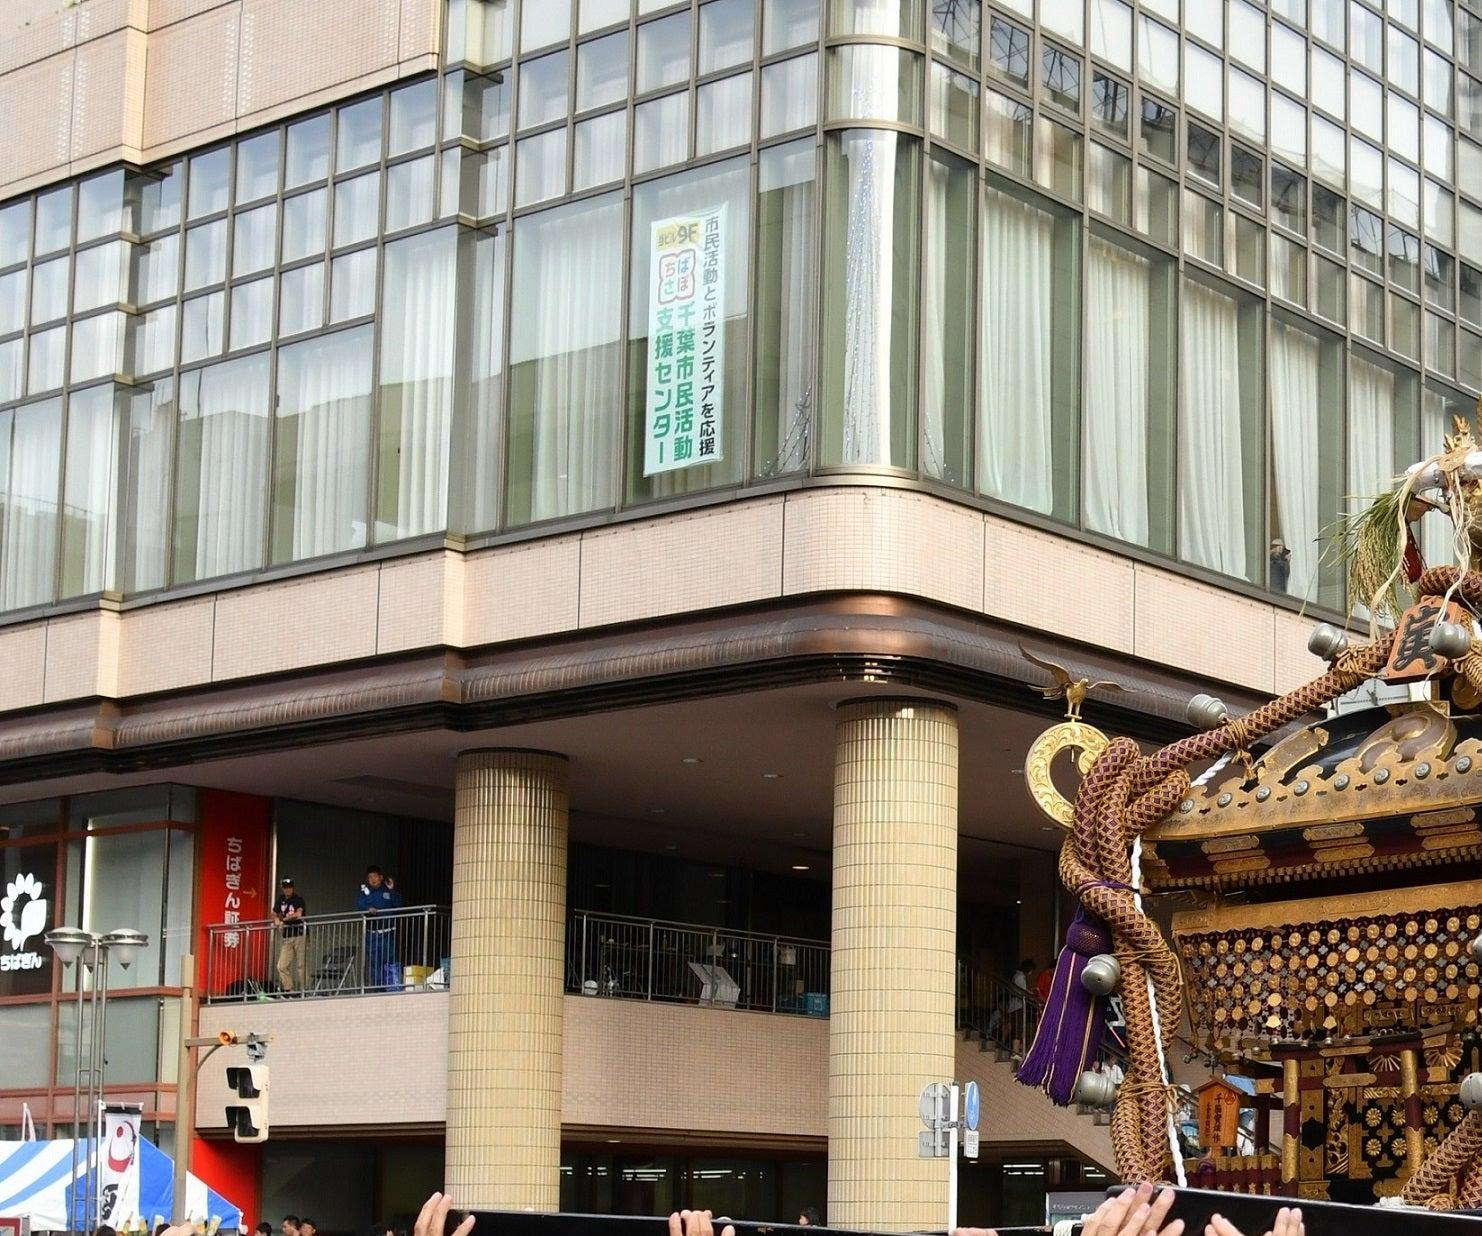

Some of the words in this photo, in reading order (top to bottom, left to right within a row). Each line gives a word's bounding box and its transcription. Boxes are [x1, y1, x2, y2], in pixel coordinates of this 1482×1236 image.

[653, 307, 674, 465] 支援センター
[674, 302, 696, 462] 千葉市民活動
[698, 216, 720, 457] 市民活動とボランティアを応援
[0, 952, 42, 971] ちばぎん
